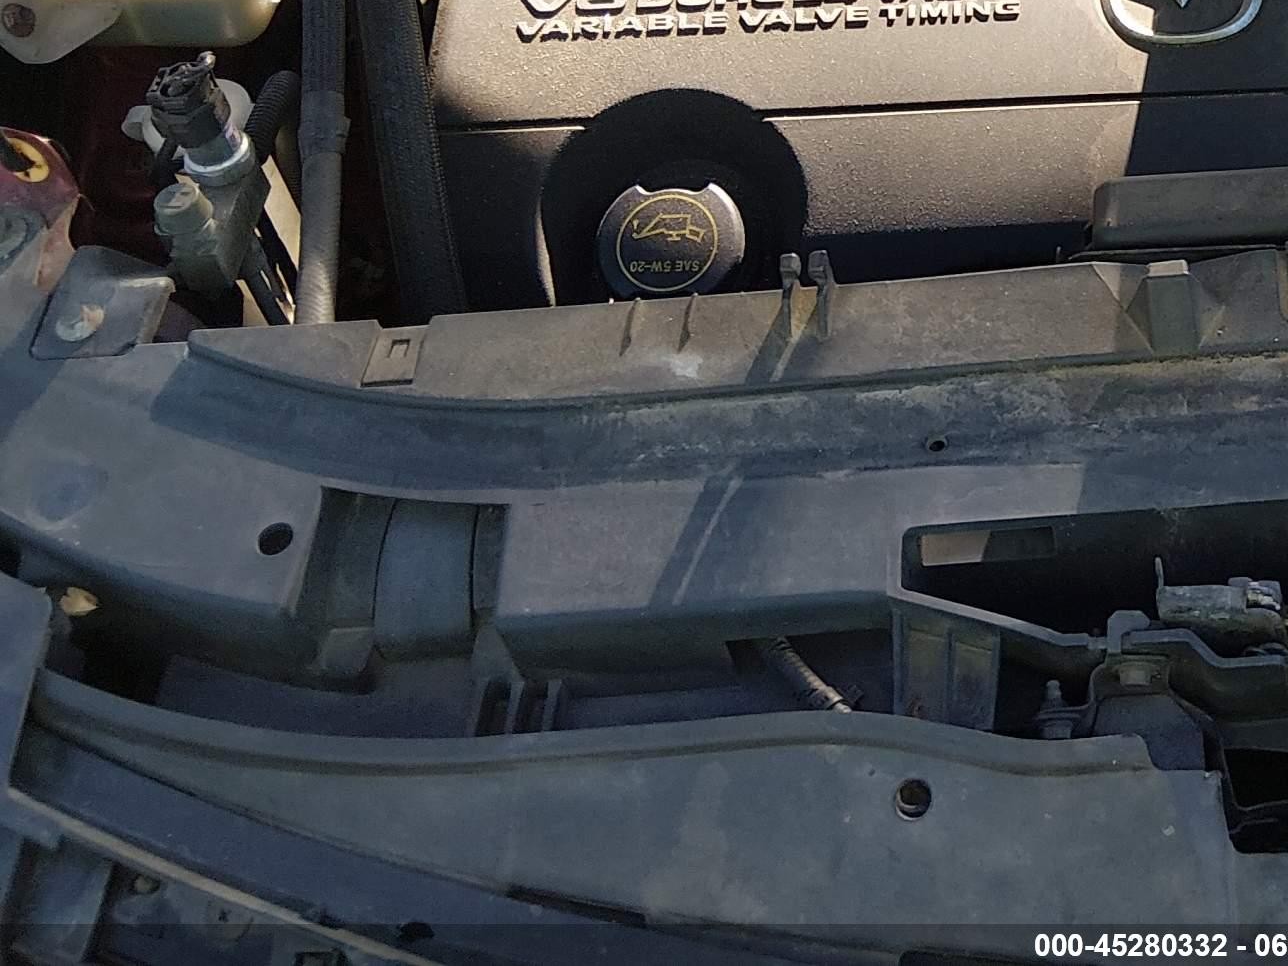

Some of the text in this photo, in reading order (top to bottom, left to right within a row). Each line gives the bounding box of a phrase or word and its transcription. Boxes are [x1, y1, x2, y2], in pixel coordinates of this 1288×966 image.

[516, 0, 1021, 43] VARIABLE VALVE TIMING
[629, 259, 701, 273] SAE 5W-20
